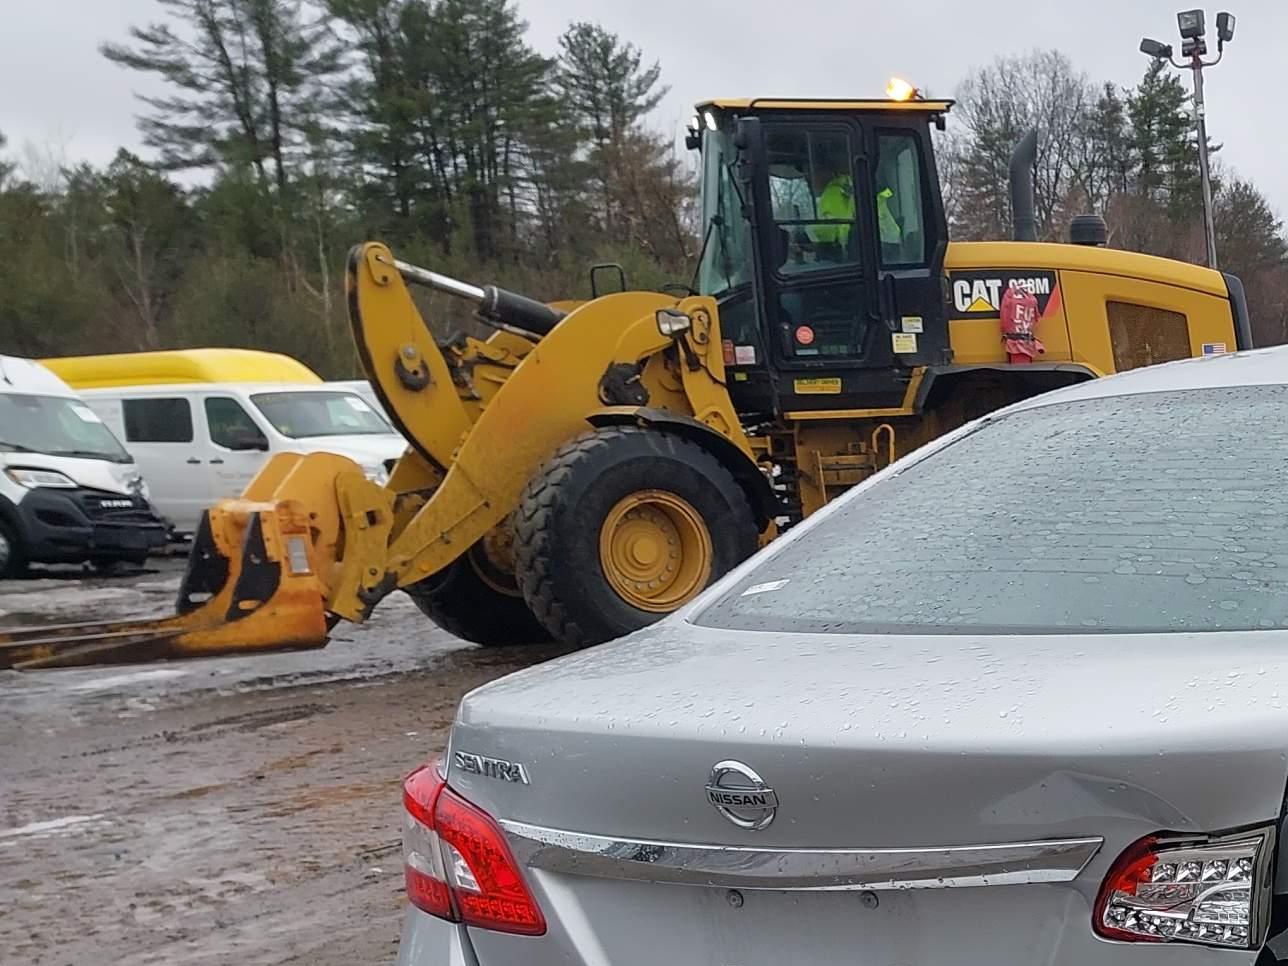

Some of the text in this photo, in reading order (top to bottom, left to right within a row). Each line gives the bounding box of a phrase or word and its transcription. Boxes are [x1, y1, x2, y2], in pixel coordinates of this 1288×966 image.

[953, 279, 1002, 312] CAT
[455, 750, 532, 785] SENTRA
[710, 791, 767, 806] NISSAN
